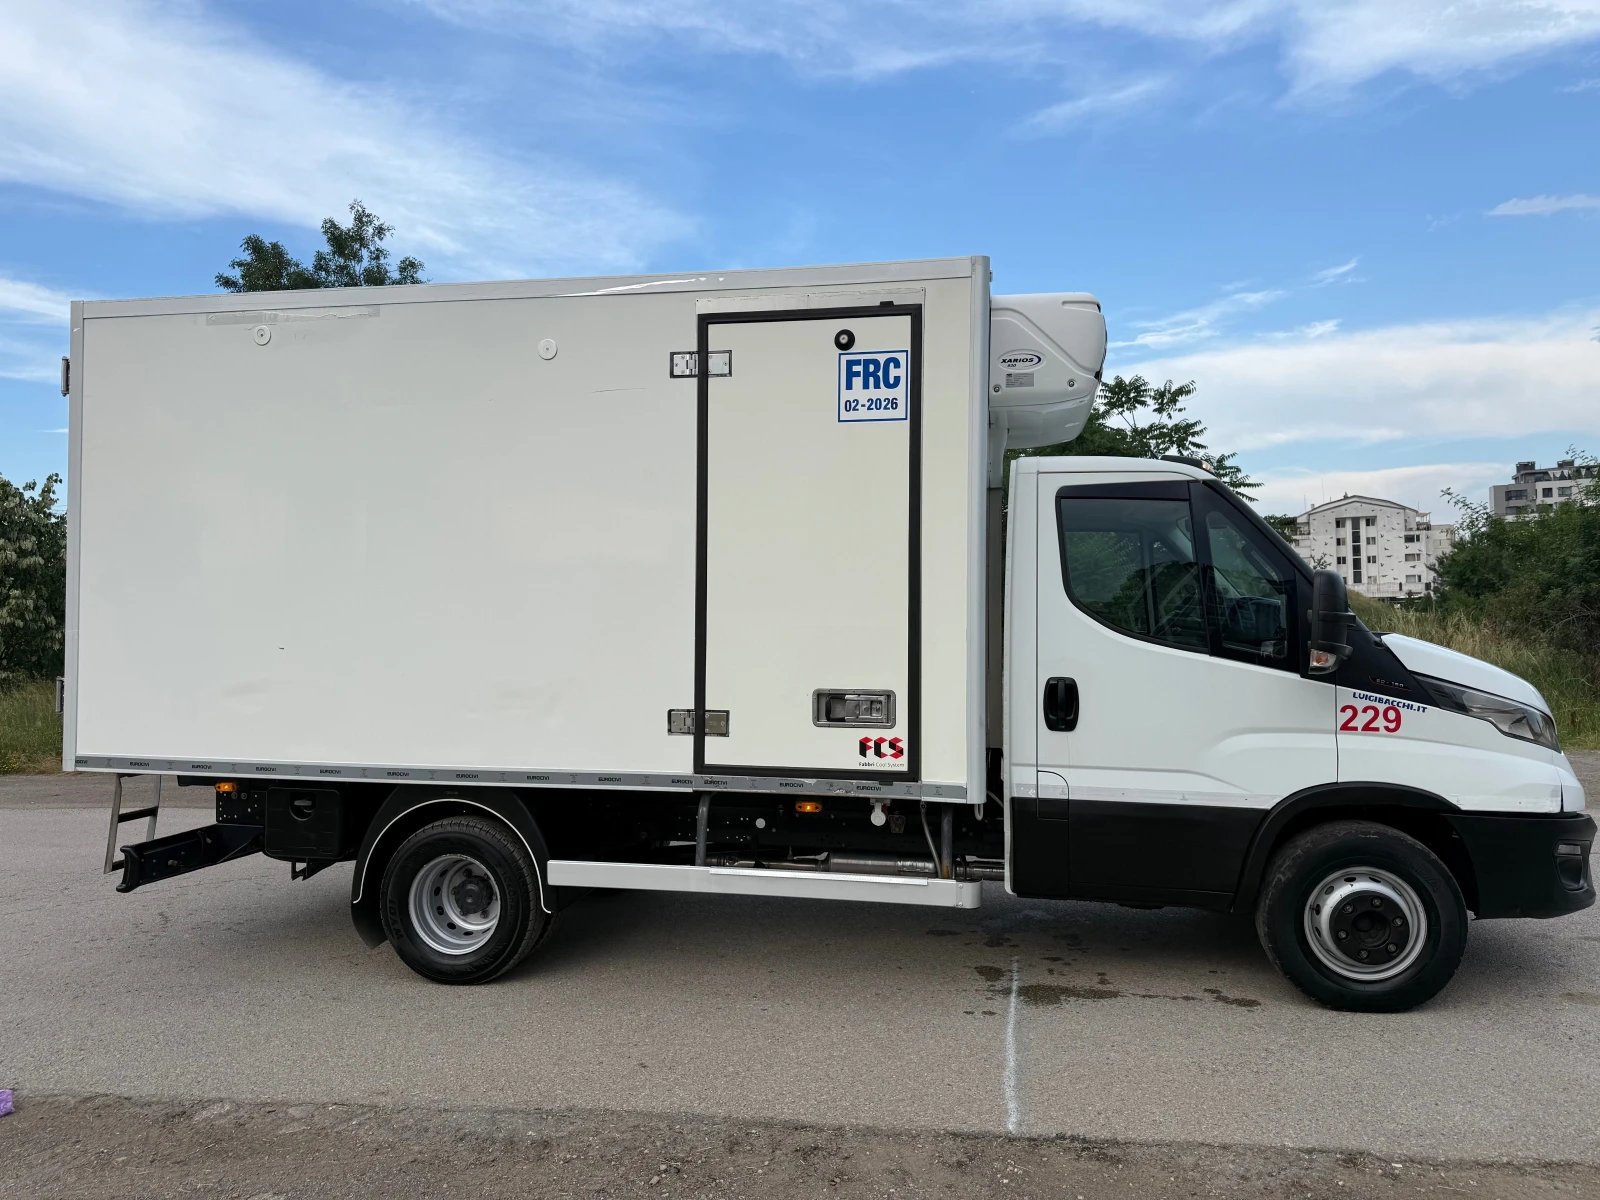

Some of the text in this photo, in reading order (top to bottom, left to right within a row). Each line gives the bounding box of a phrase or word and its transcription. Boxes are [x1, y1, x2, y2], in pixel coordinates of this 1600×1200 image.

[845, 357, 901, 390] FRC
[844, 397, 899, 412] 02-2026
[1352, 691, 1428, 713] LUIGIBACCHI.IT
[1339, 704, 1402, 733] 229
[859, 736, 904, 759] FCS
